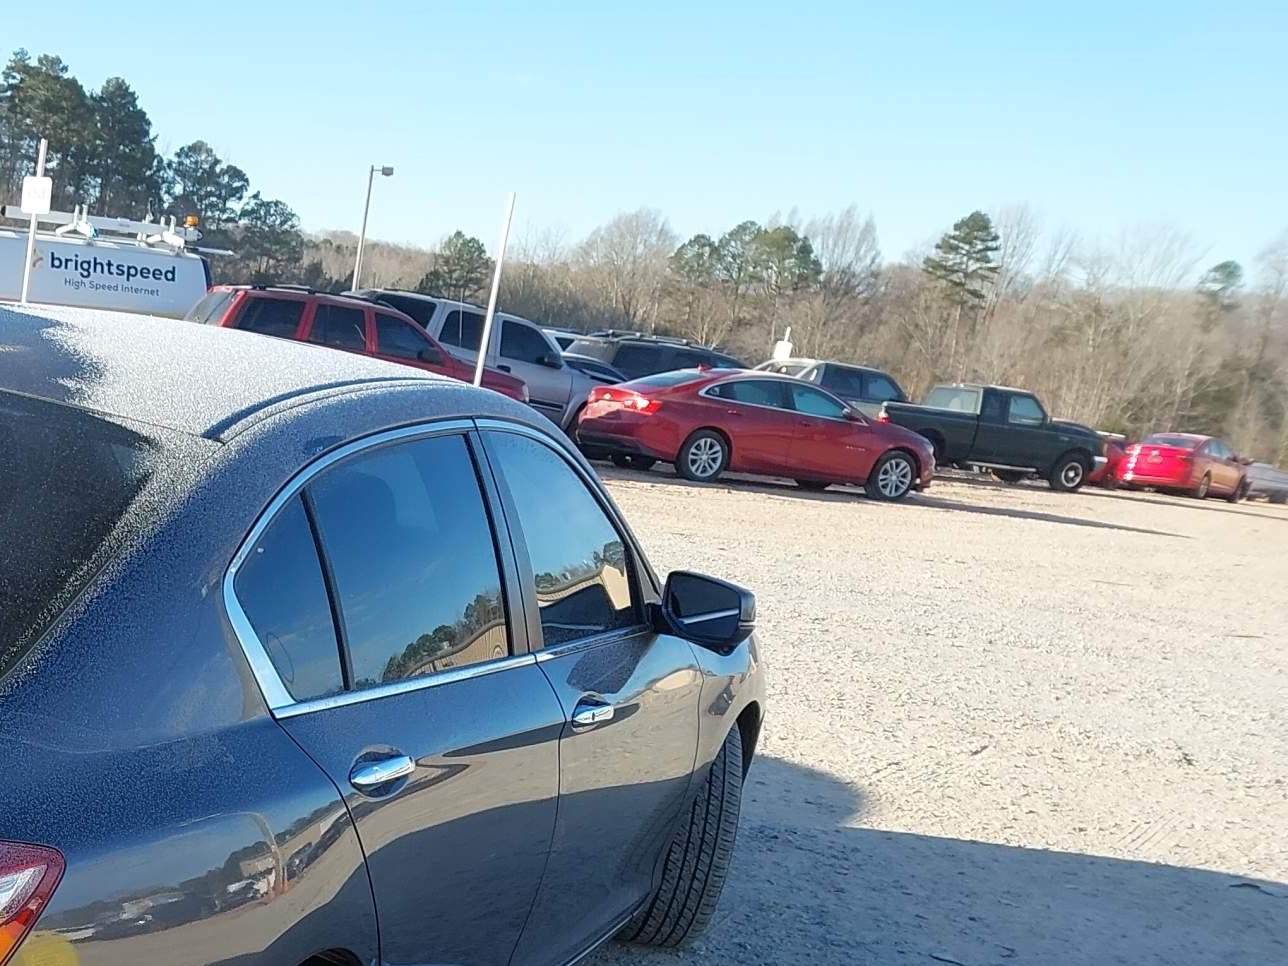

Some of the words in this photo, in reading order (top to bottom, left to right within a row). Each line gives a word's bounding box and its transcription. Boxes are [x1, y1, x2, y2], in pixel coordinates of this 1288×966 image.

[50, 252, 176, 282] brightspeed
[64, 278, 86, 290] High
[89, 281, 119, 292] Speed
[121, 285, 160, 296] Internet
